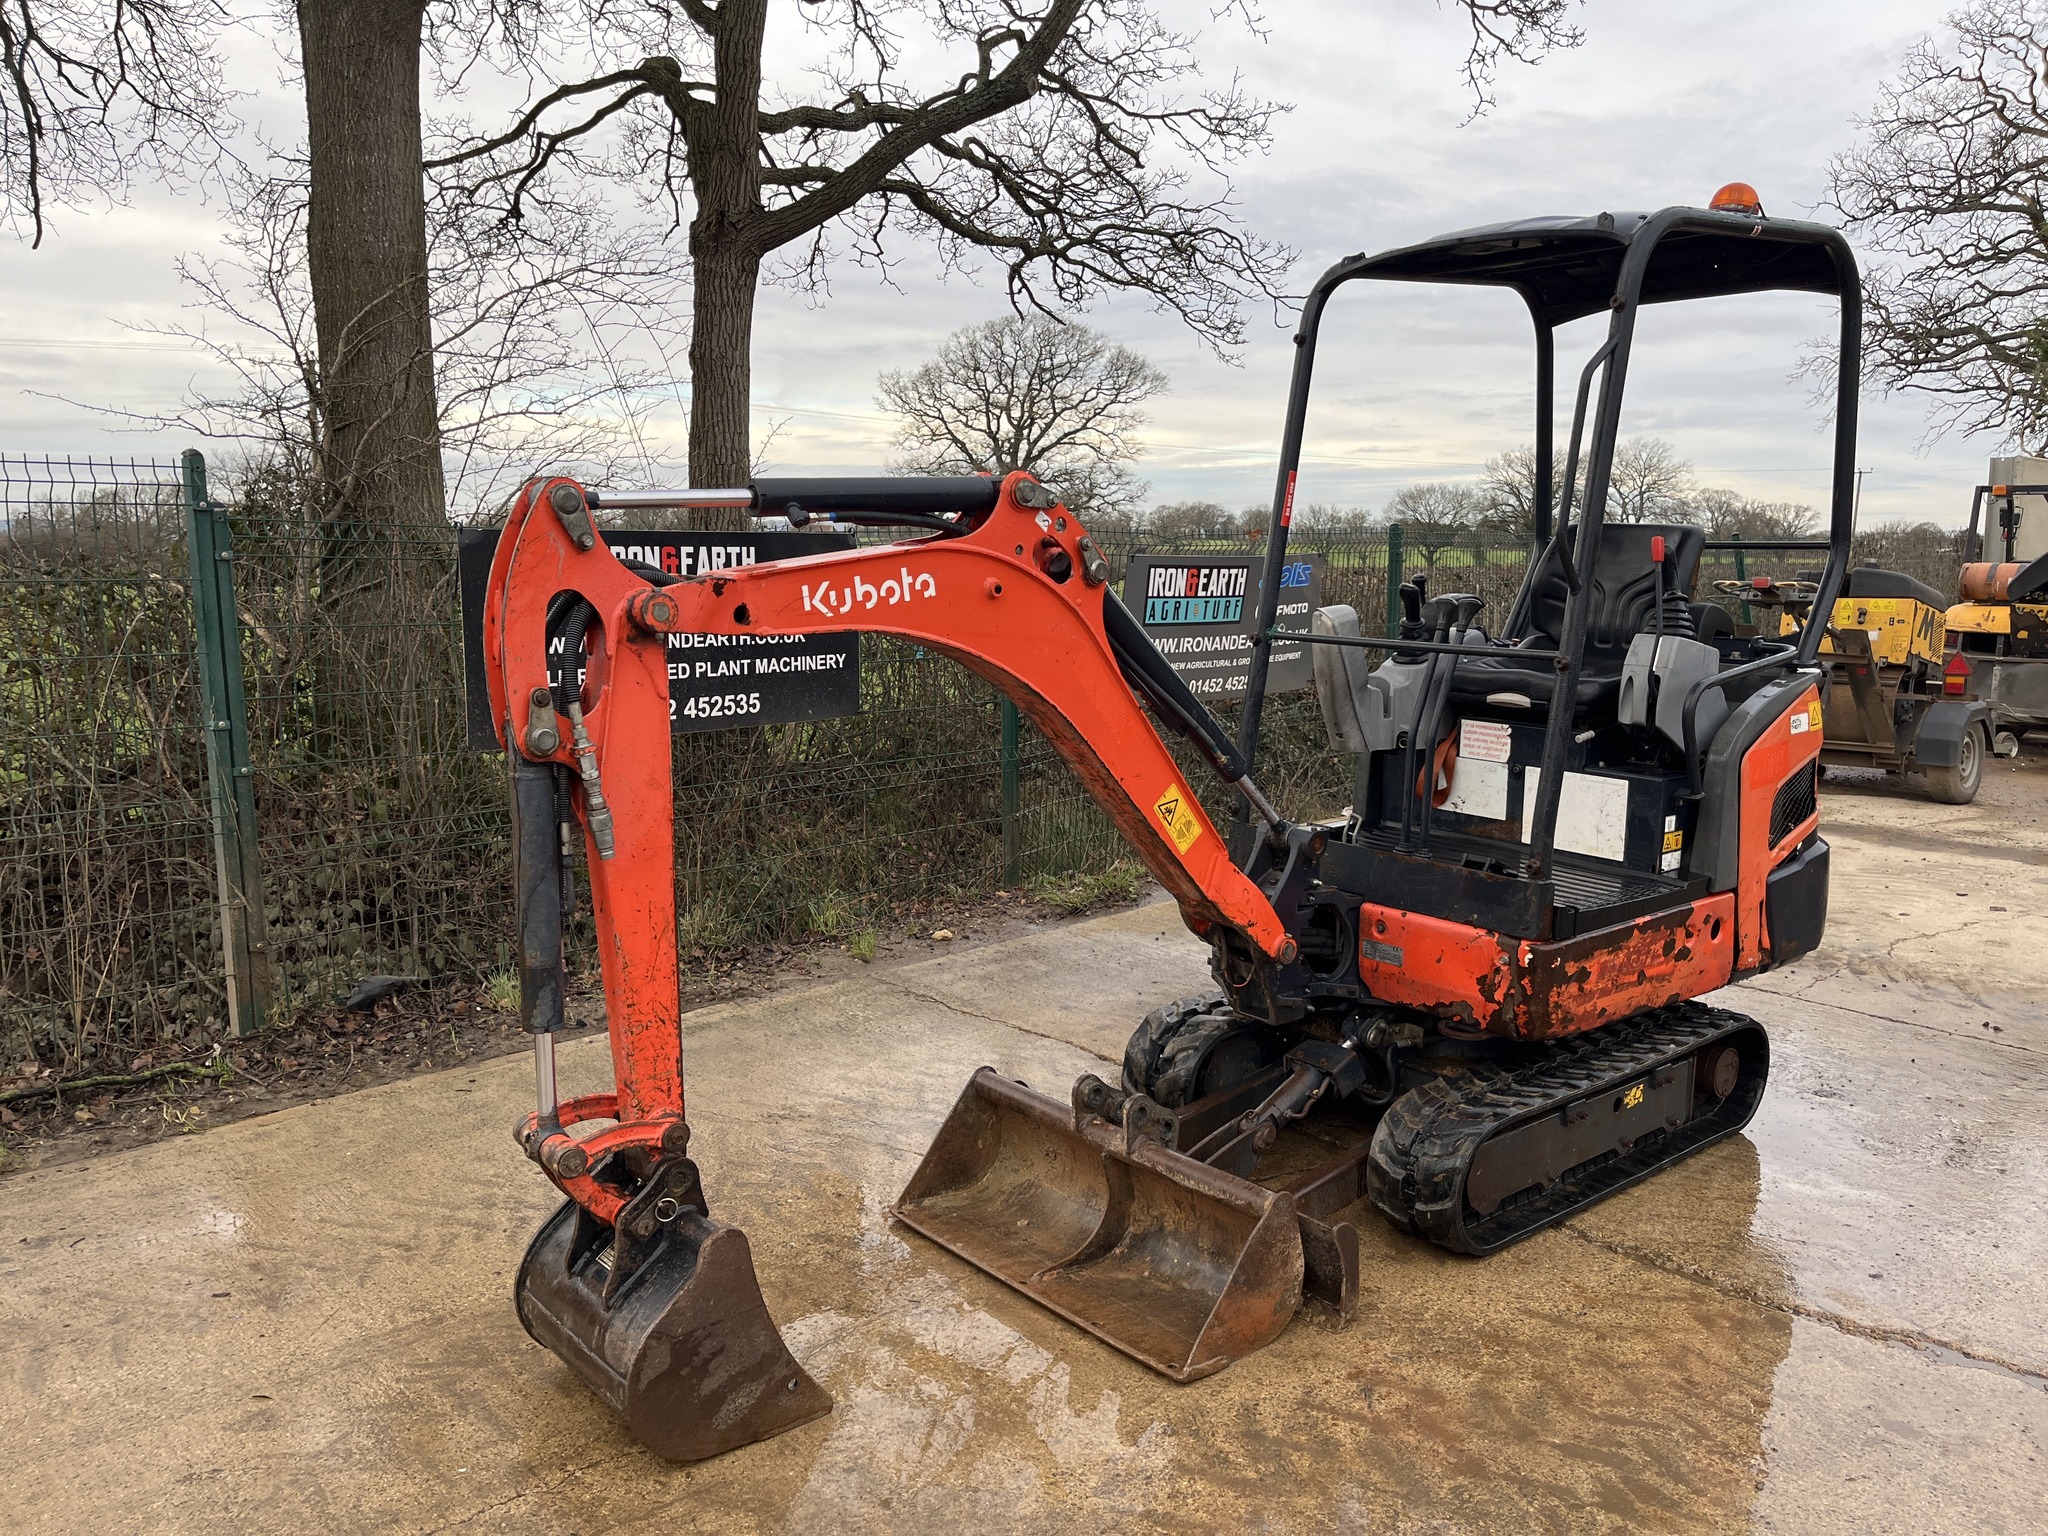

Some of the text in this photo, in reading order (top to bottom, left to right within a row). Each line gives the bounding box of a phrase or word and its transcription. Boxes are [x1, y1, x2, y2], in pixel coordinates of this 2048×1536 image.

[609, 545, 755, 575] ON&EARTH
[801, 567, 937, 618] Kubota
[1148, 567, 1248, 597] IRON&EARTH
[1148, 599, 1240, 621] AGRI TURF
[1917, 607, 1936, 651] M
[695, 659, 751, 678] PLANT
[755, 653, 846, 674] MACHINERY
[1170, 661, 1187, 670] NEW
[1186, 659, 1232, 670] AGRICULTURAL
[1232, 658, 1237, 666] &
[1275, 651, 1302, 662] EQUIPMENT
[1189, 677, 1223, 694] 01452
[684, 693, 761, 719] 452535
